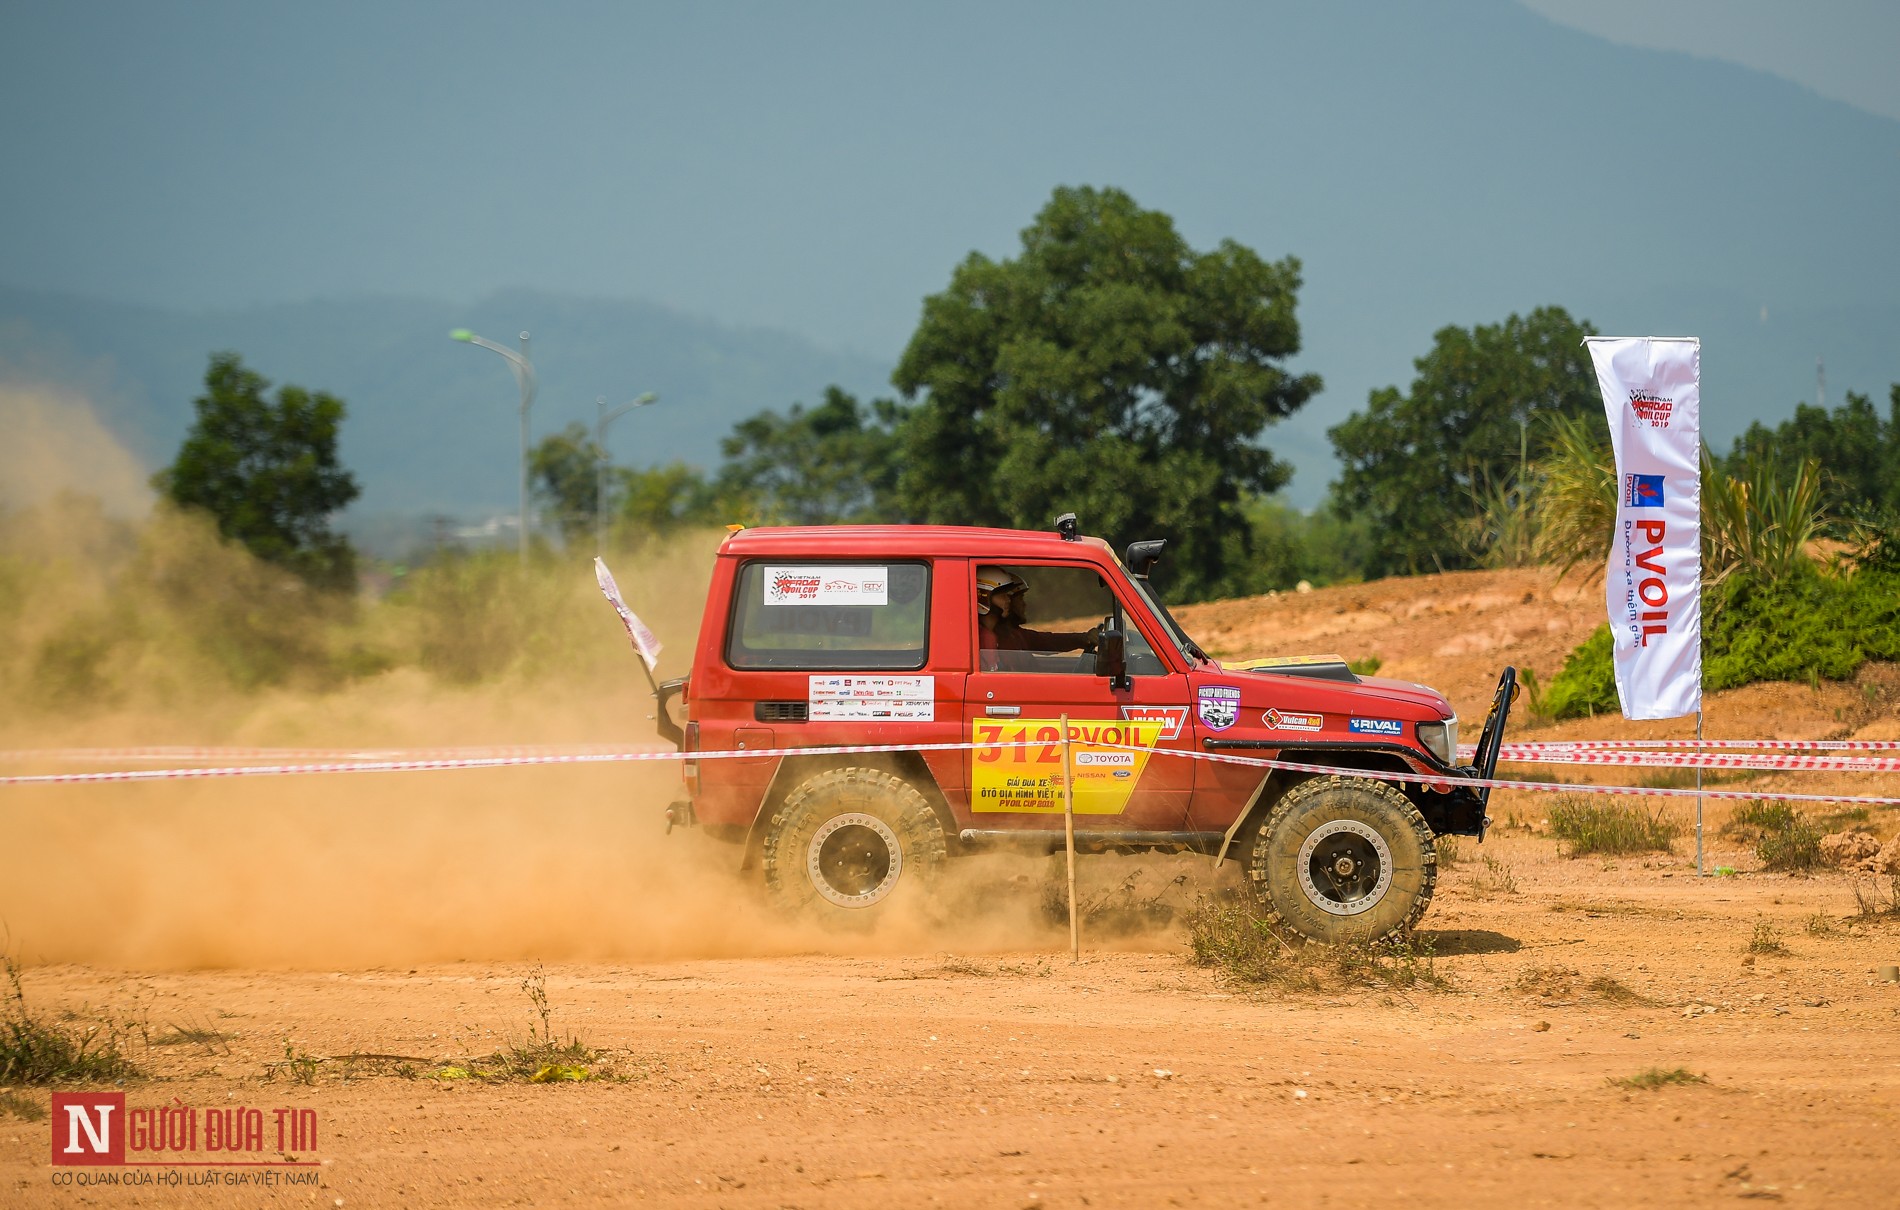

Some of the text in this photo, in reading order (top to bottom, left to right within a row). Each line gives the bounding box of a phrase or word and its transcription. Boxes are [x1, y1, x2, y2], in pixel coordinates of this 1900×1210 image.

[1654, 411, 1671, 420] CUP
[1626, 571, 1632, 585] xa
[1635, 520, 1669, 647] PVOIL
[1627, 590, 1637, 621] thêm
[1198, 688, 1240, 699] PICKUP AND FRIENDS
[1283, 716, 1320, 726] Vulcan 4x4
[1361, 720, 1401, 730] RIVAL
[1068, 726, 1148, 747] PVOIL
[977, 726, 1061, 764] 312
[1038, 779, 1048, 787] XE
[1023, 800, 1037, 808] CUP
